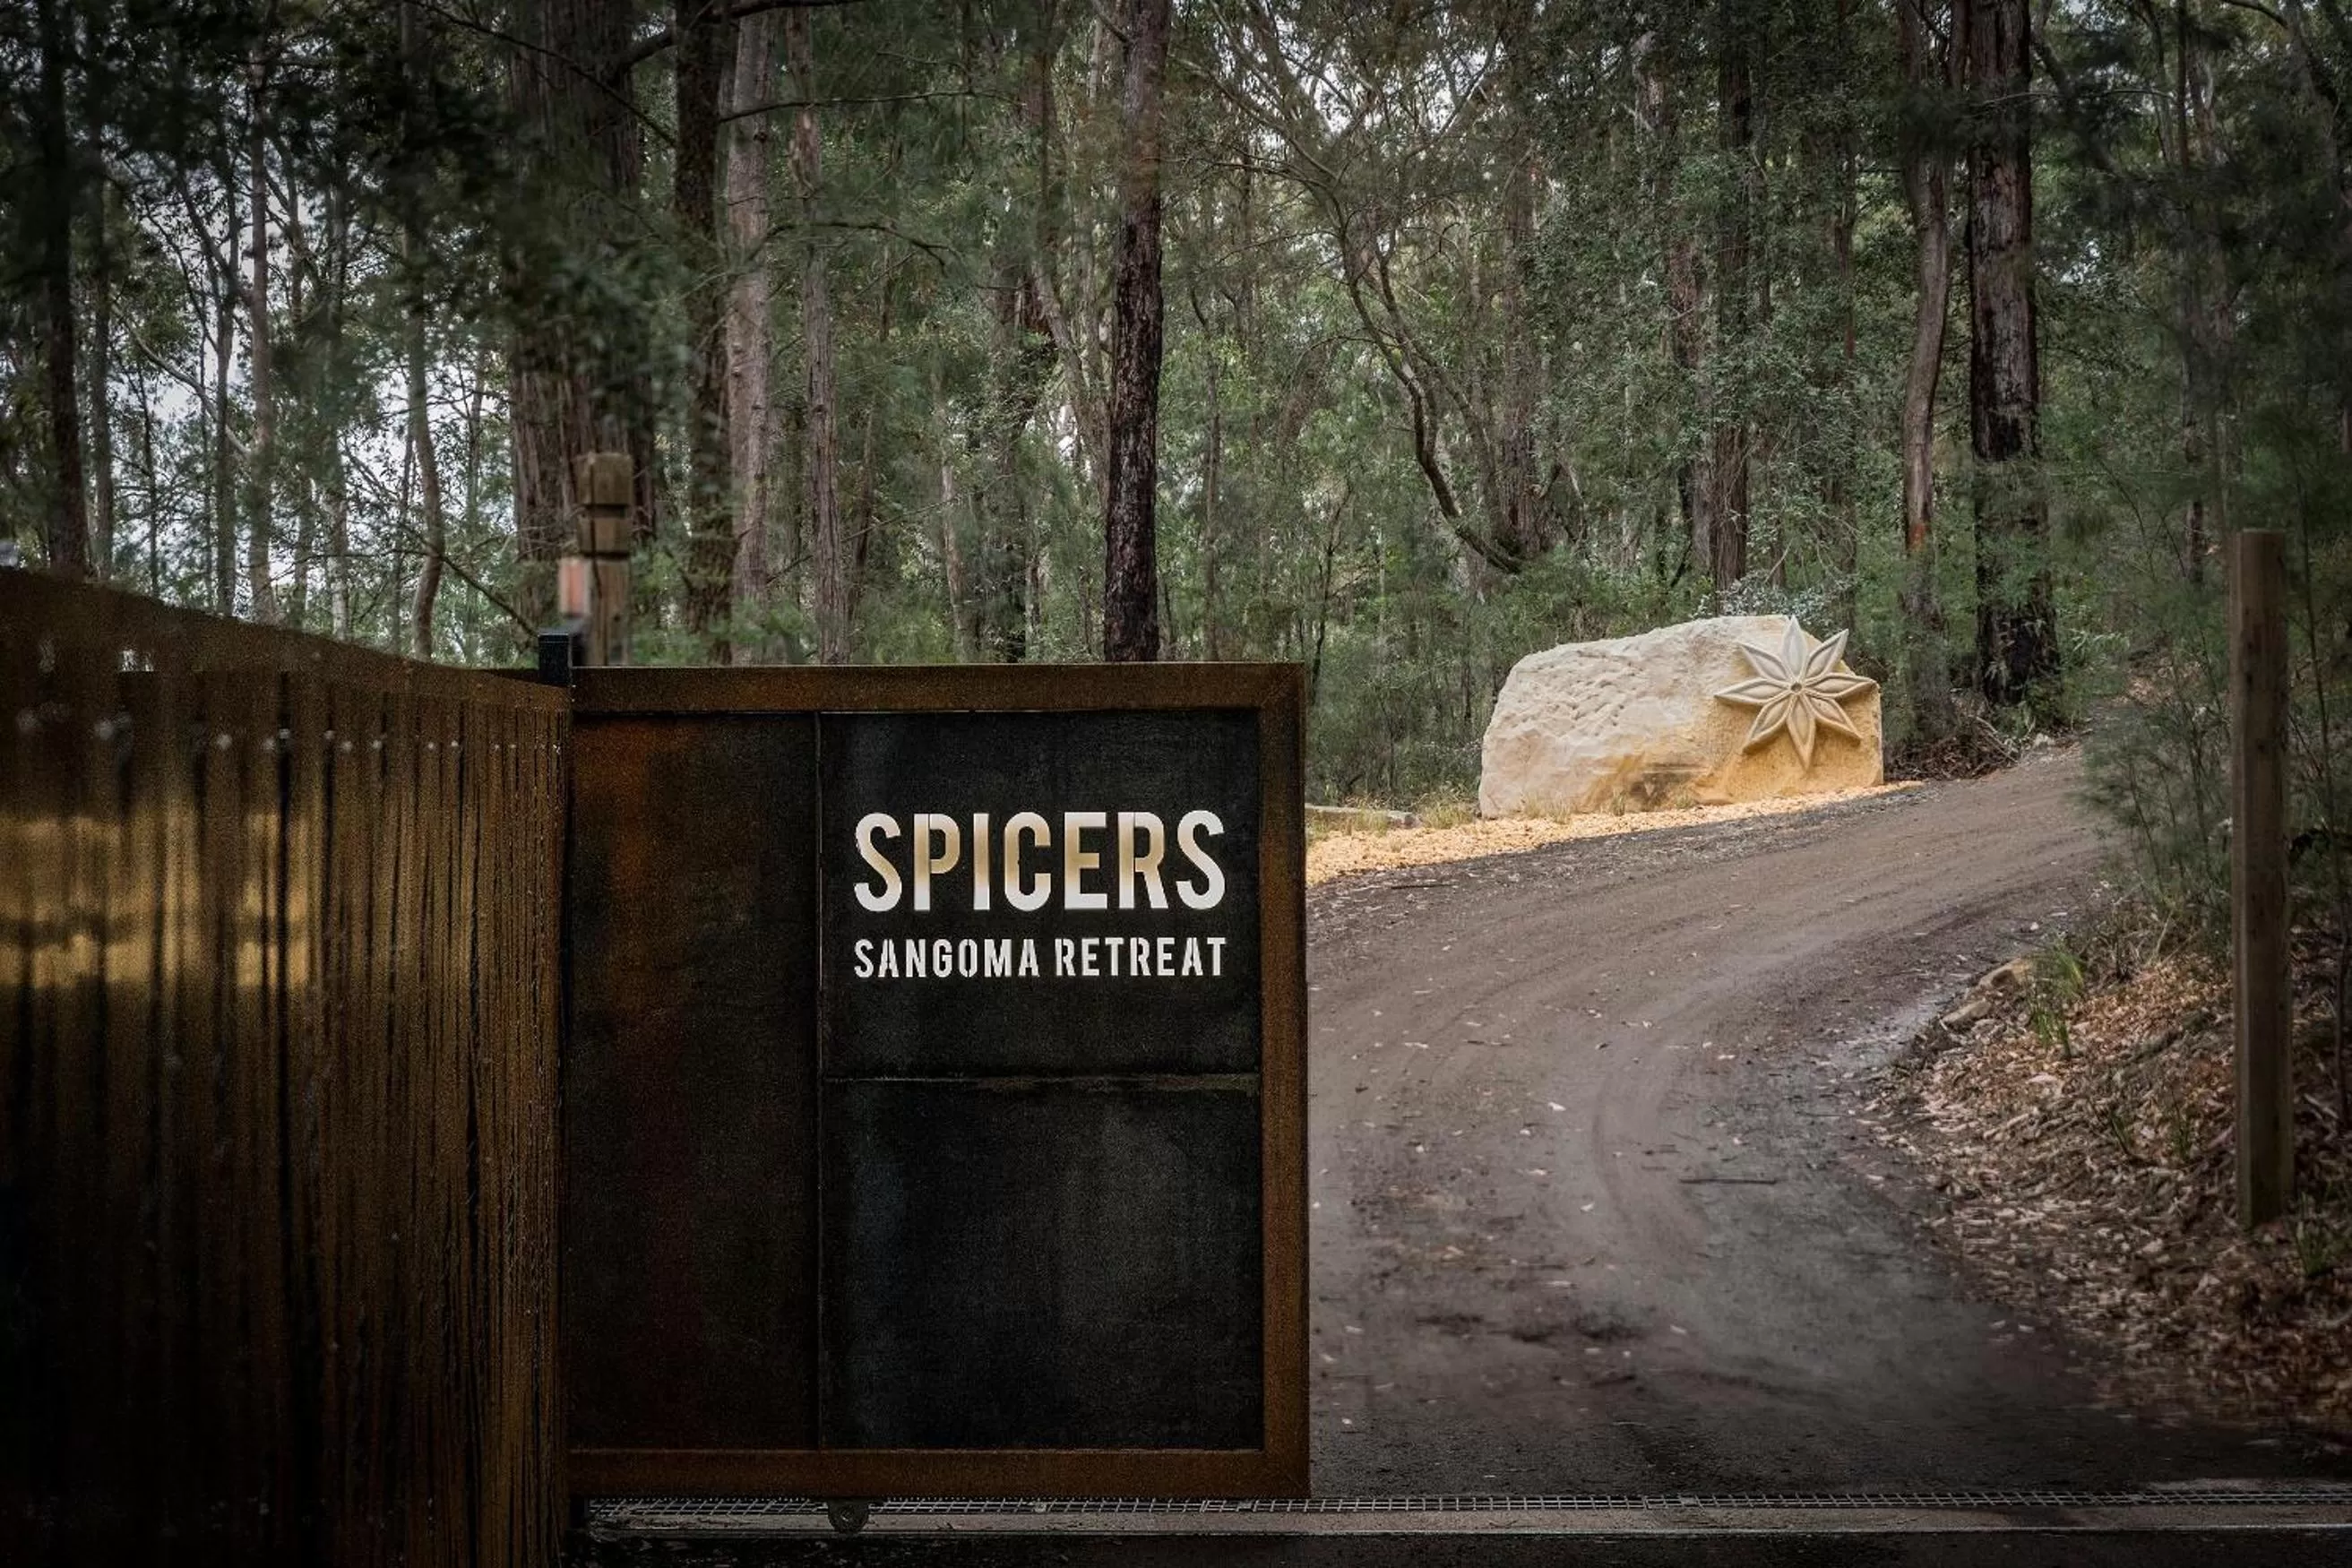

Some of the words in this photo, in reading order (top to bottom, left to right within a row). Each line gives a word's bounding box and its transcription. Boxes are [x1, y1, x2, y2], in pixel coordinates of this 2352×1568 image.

[854, 810, 1226, 912] SPICERS
[854, 937, 1040, 978] SANGOMA
[1055, 936, 1227, 978] RETREAT
